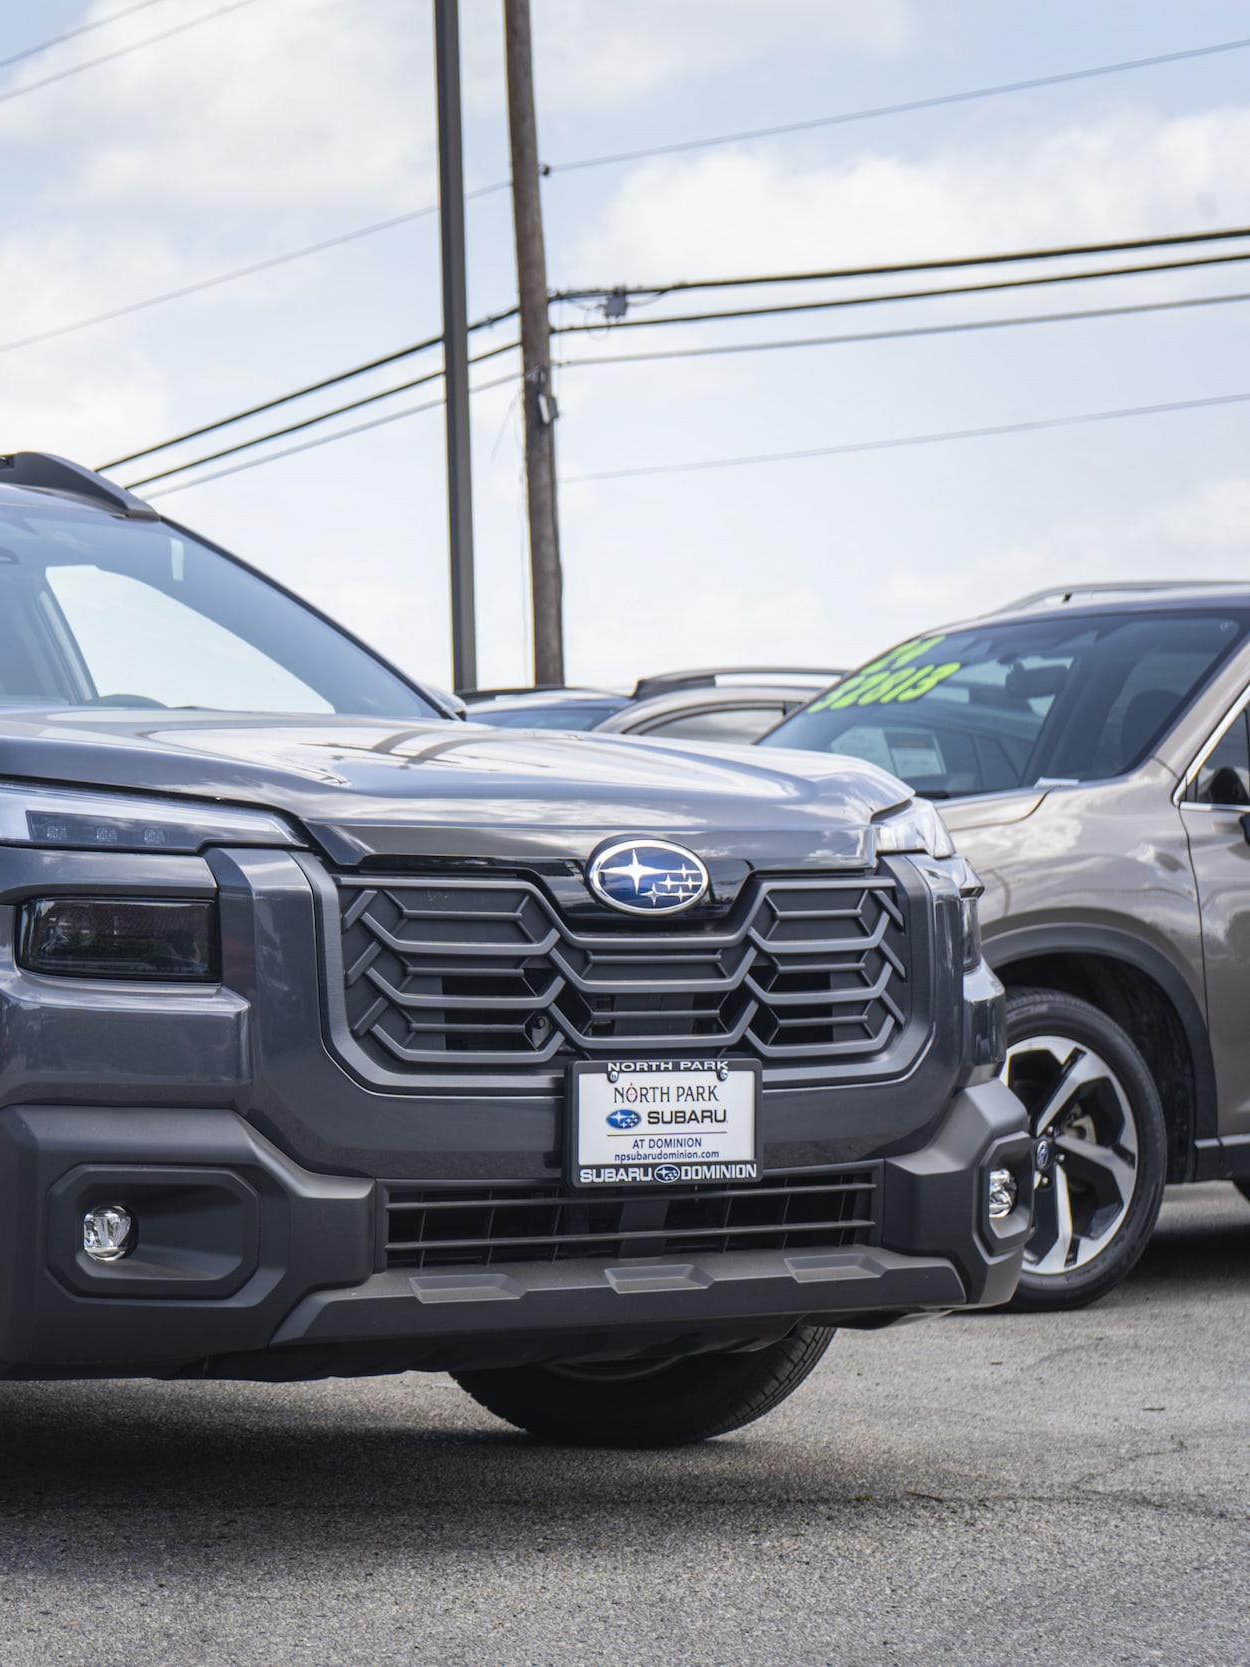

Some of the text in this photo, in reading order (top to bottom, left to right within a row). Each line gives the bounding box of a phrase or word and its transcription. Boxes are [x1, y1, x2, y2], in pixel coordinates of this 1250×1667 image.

[607, 1060, 729, 1072] NORTH PARK
[614, 1085, 719, 1104] NORTH PARK
[647, 1109, 727, 1125] SUBARU
[632, 1137, 702, 1150] AT DOMINION
[614, 1150, 720, 1164] npsubarudominion.com
[579, 1164, 757, 1184] SUBARU DOMINION
